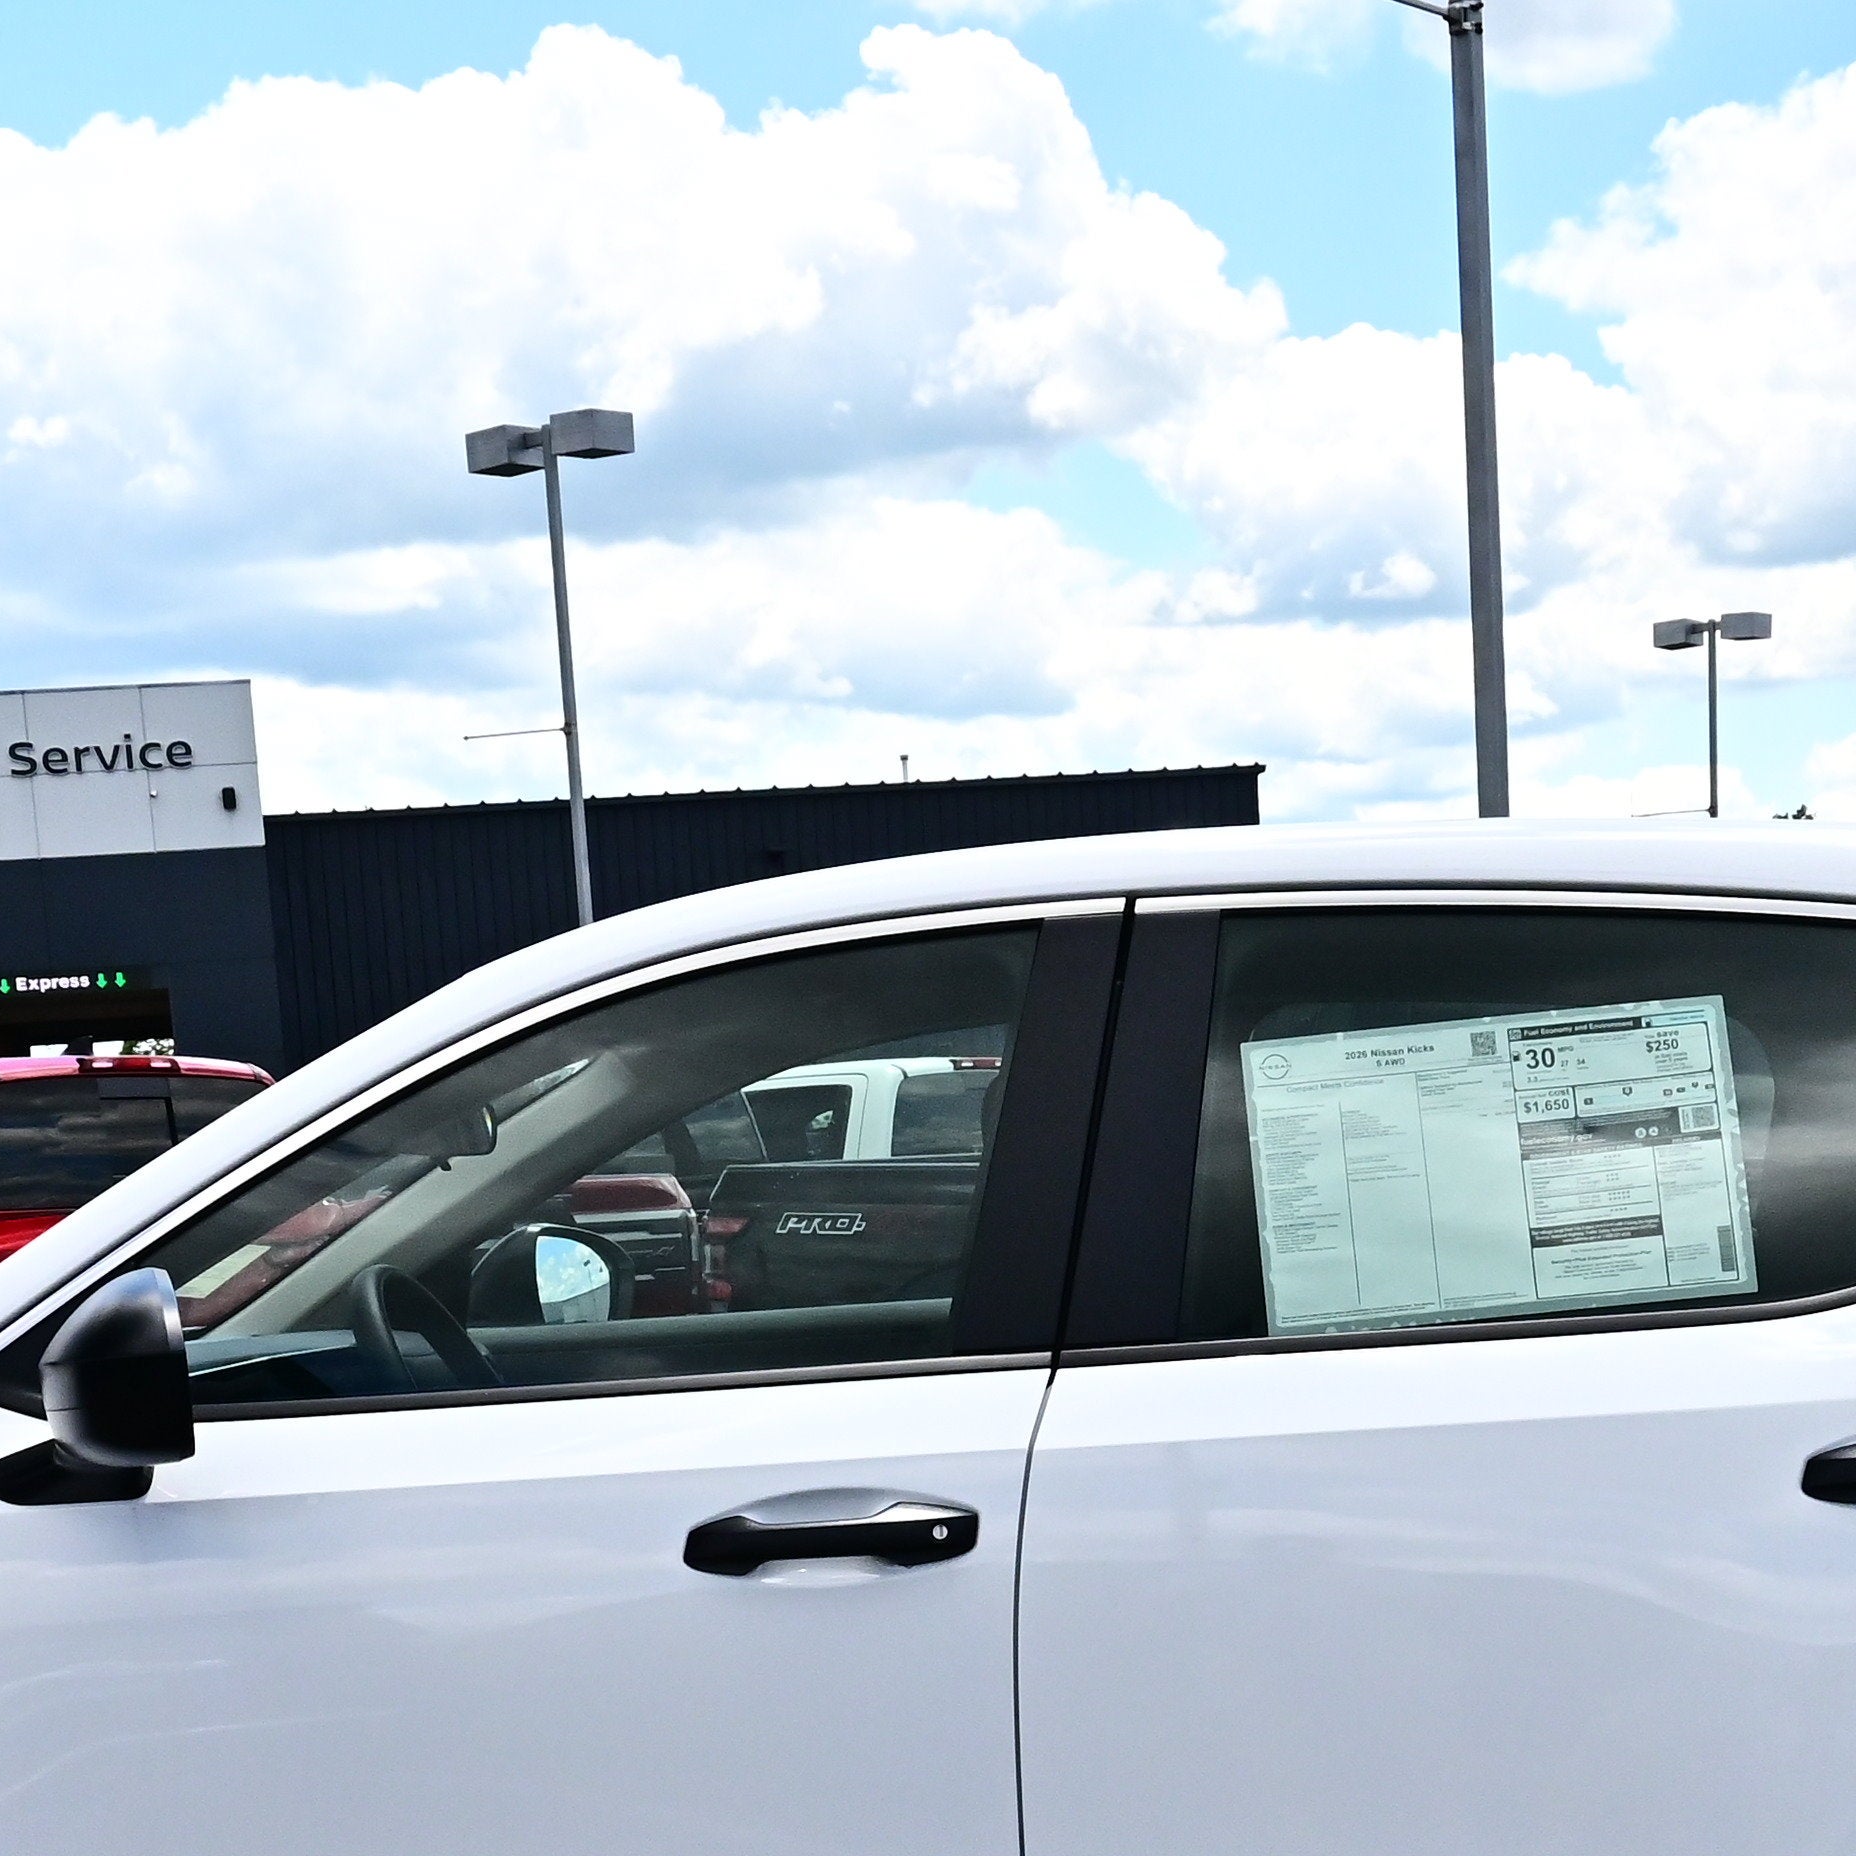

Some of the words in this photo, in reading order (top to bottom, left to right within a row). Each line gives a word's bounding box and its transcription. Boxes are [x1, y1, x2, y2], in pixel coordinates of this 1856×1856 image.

[8, 733, 194, 777] Service
[14, 974, 91, 993] Express
[1523, 1028, 1540, 1037] Fuel
[1541, 1025, 1572, 1036] Economy
[1574, 1022, 1588, 1031] and
[1588, 1019, 1634, 1030] Environment
[1370, 1047, 1404, 1058] Nissan
[1407, 1044, 1435, 1055] Kicks
[1645, 1038, 1679, 1053] $250
[1384, 1058, 1406, 1067] AWD
[1525, 1047, 1556, 1069] 30
[1523, 1098, 1570, 1114] $1,650
